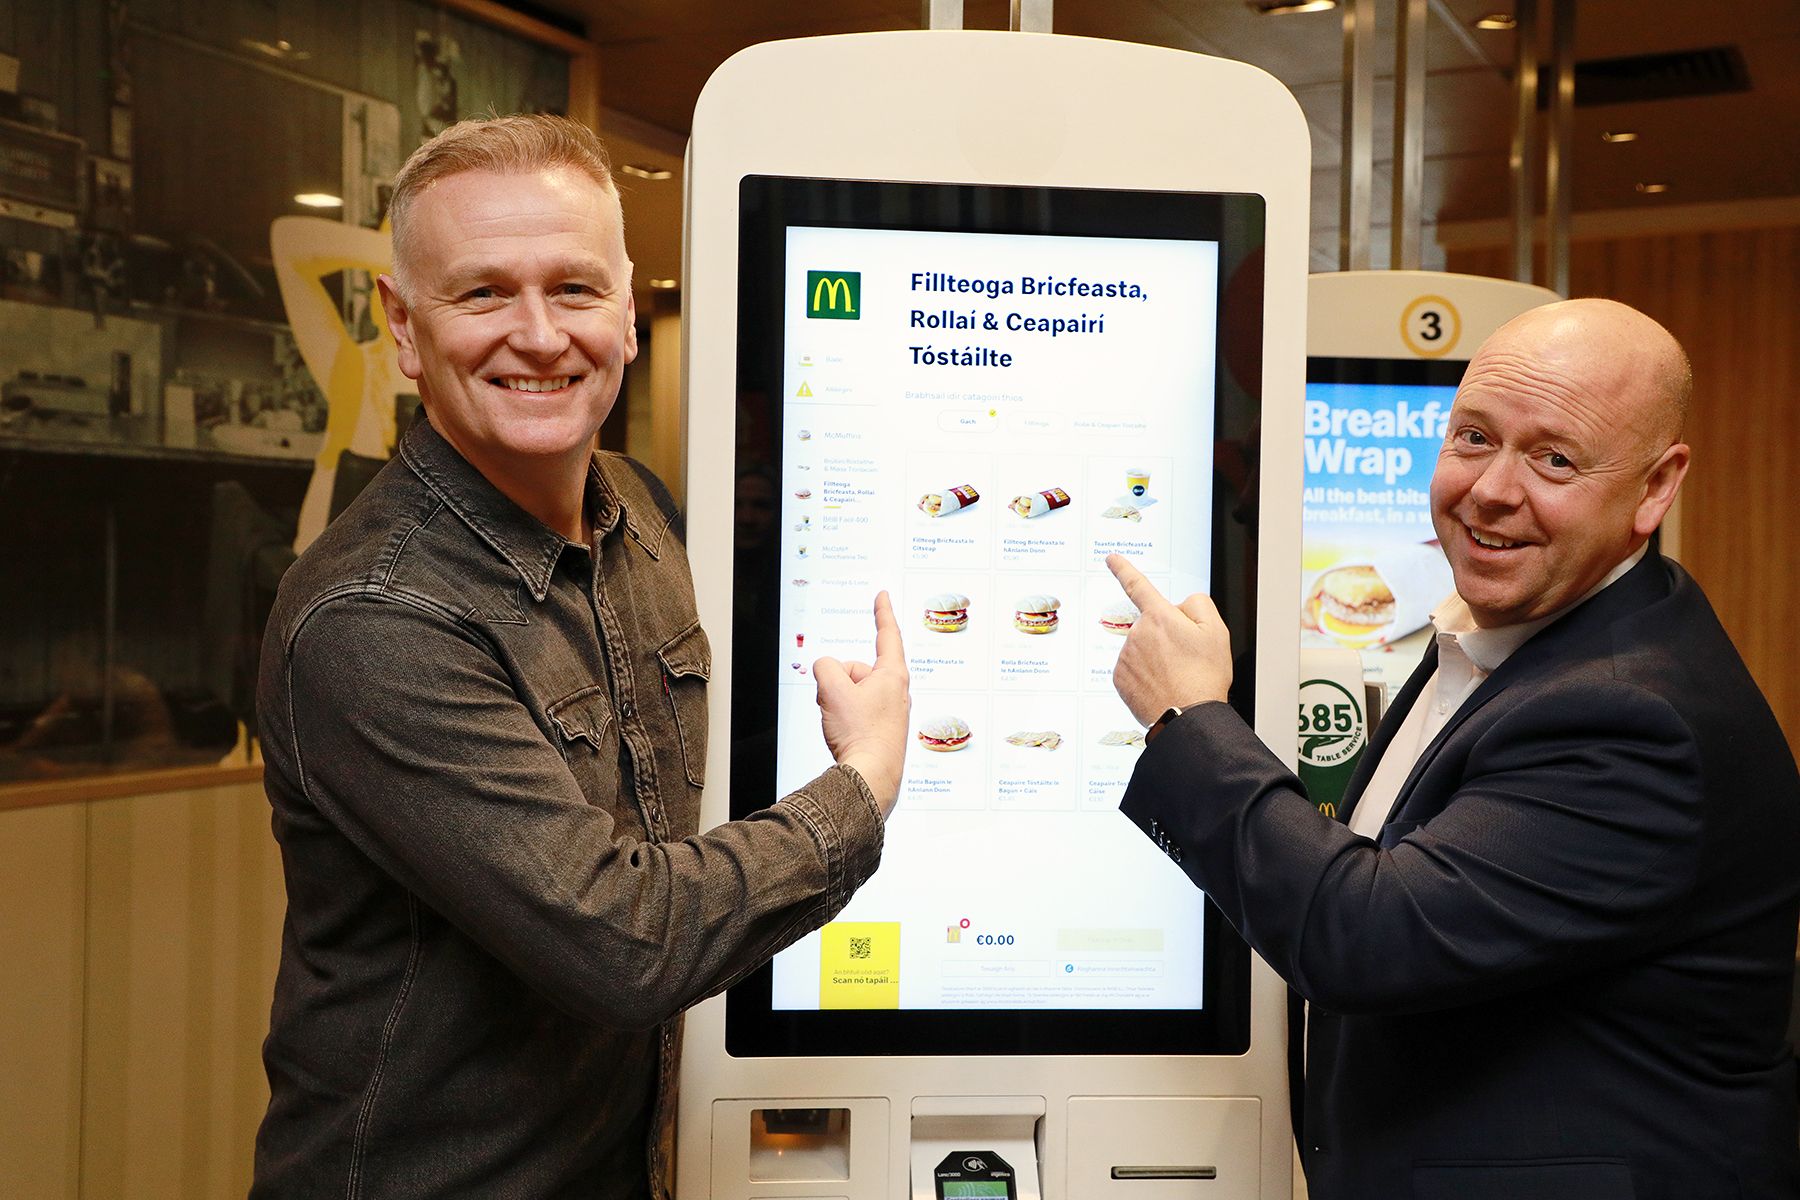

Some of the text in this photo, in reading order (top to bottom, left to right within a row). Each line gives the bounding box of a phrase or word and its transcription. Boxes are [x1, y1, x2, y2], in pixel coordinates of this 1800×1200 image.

[911, 272, 1147, 302] Fillteoga Bricfeasta,
[910, 310, 1105, 337] Rollaí & Ceapairí
[1420, 311, 1442, 341] 3
[909, 344, 1013, 367] Tóstáilte
[1304, 401, 1452, 438] Breakfa
[1304, 438, 1413, 485] Wrap
[1304, 487, 1428, 506] All the best bits
[1303, 506, 1385, 525] breakfast,
[1387, 508, 1401, 524] in
[1403, 511, 1414, 524] a
[1298, 704, 1352, 732] 685
[1316, 726, 1363, 762] TABLE SERVICE
[976, 934, 1014, 946] €0.00
